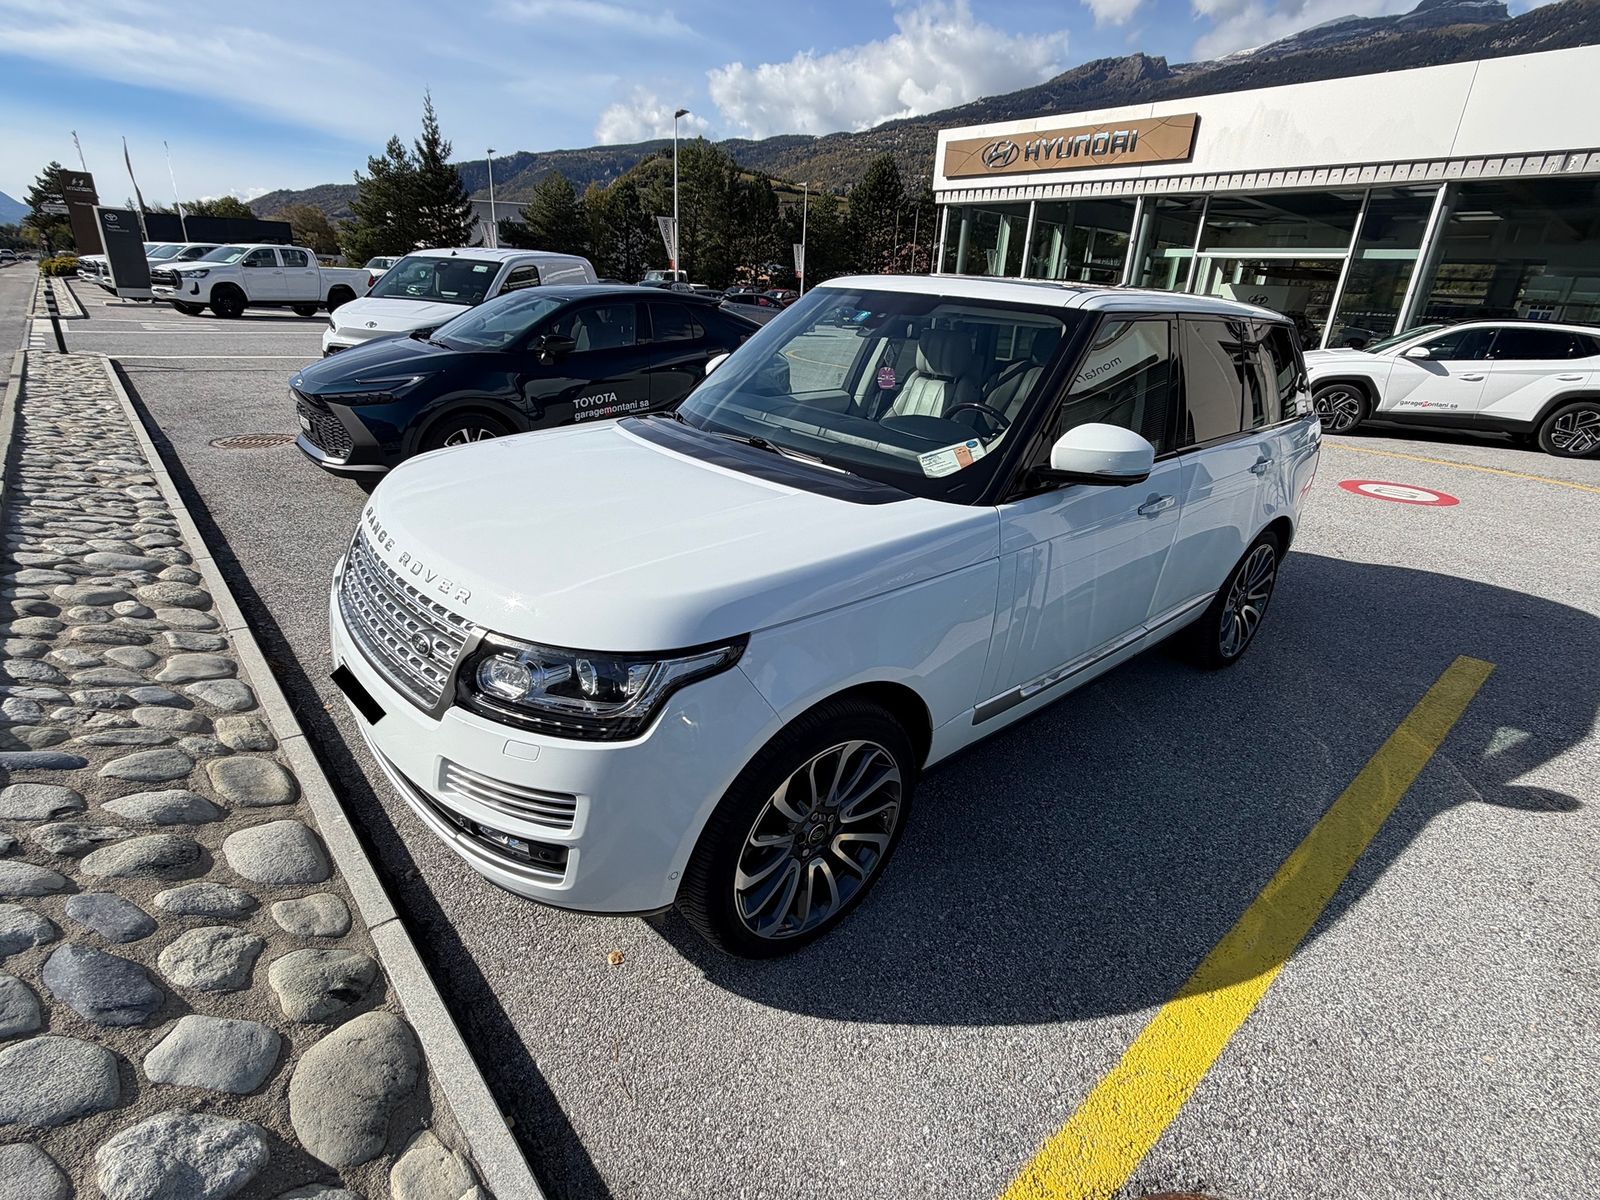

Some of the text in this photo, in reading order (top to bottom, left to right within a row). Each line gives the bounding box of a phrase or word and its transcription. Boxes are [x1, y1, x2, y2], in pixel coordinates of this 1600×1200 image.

[1024, 130, 1138, 161] HYUNDAI
[573, 392, 617, 408] TOYOTA
[574, 399, 649, 421] garagemontani sa
[366, 506, 472, 605] RANGE ROVER
